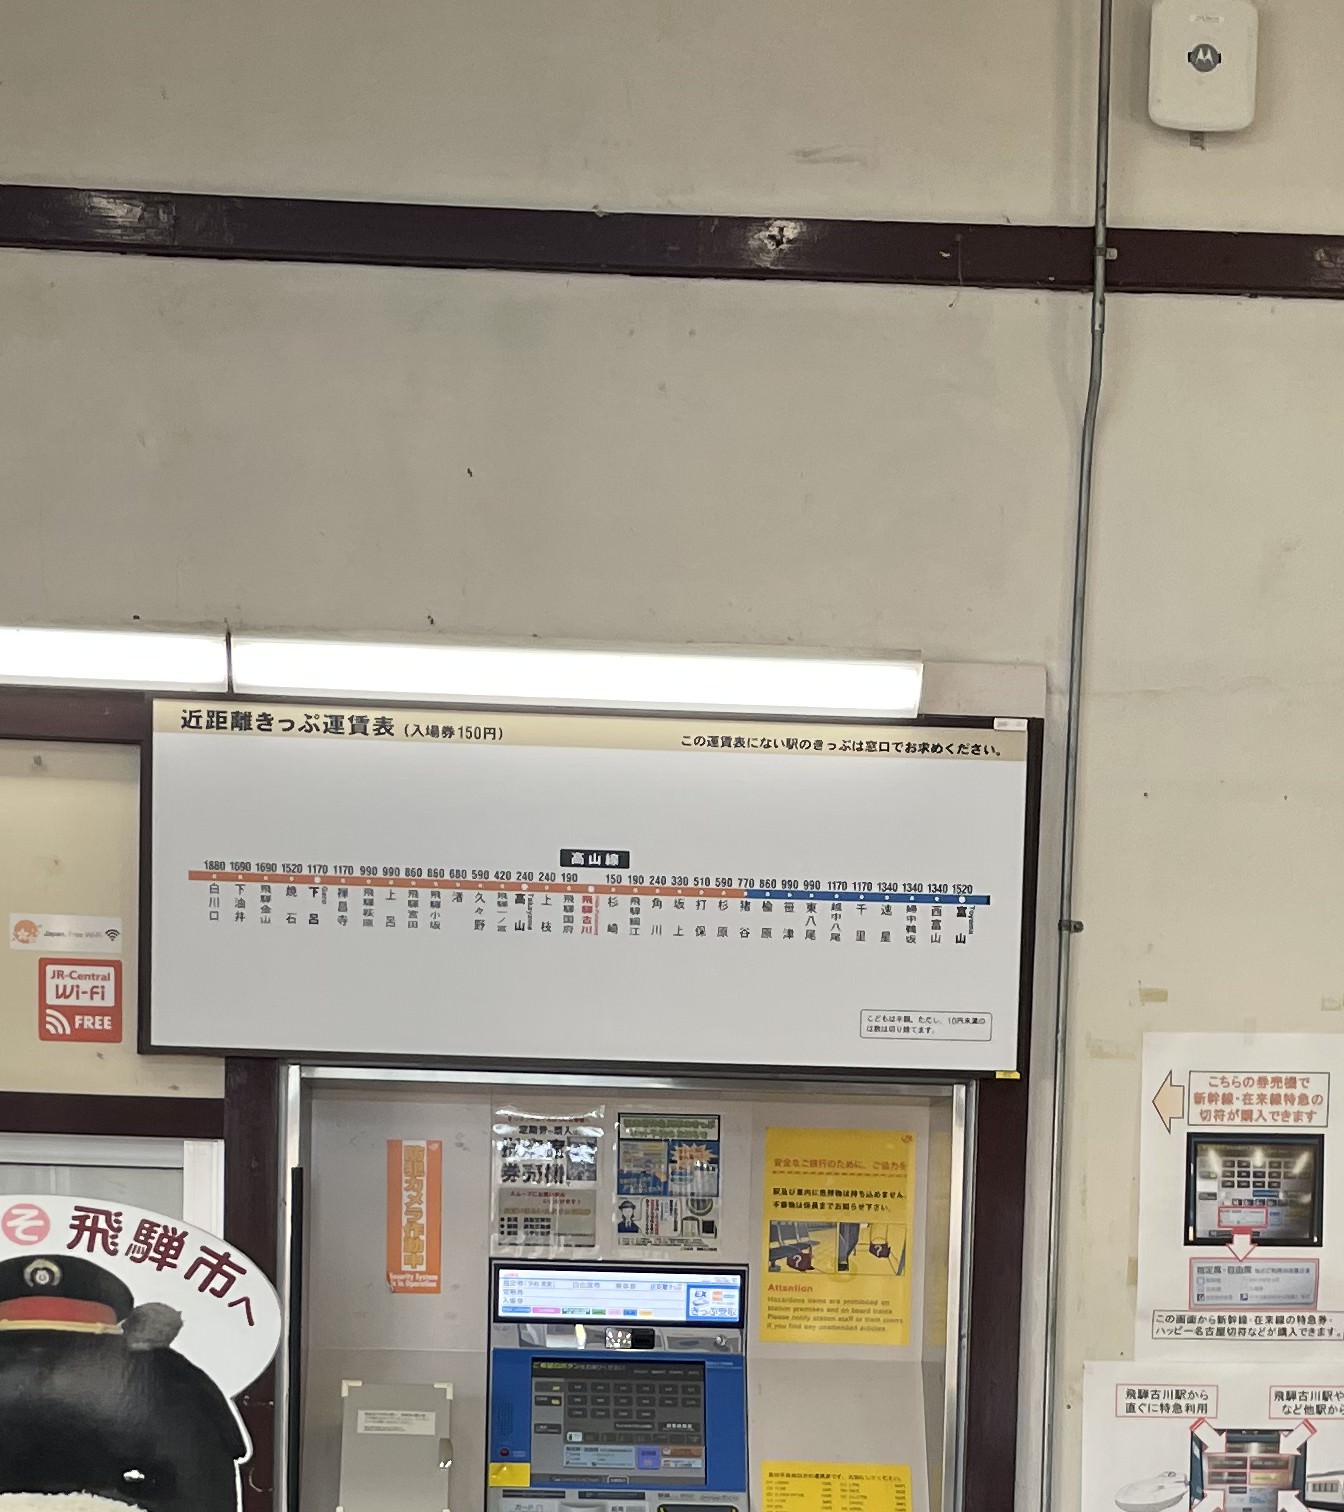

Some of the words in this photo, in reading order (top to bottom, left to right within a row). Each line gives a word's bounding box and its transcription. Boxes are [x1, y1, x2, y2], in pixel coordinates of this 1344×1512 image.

[181, 709, 395, 738] 近距離きっぷ運賃表
[405, 723, 504, 741] (入場券150円)
[681, 735, 1001, 756] この運賃表にない駅のきっぷは窓口でお求めください。
[205, 861, 225, 871] 1880
[230, 862, 251, 872] 1690
[256, 862, 277, 872] 1690
[281, 863, 303, 873] 1520
[307, 864, 328, 874] 1170
[333, 865, 354, 875] 1170
[360, 866, 378, 876] 990
[382, 867, 400, 877] 990
[472, 870, 490, 880] 590
[494, 871, 511, 881] 420
[516, 872, 533, 881] 240
[539, 872, 556, 882] 240
[561, 873, 578, 882] 190
[606, 874, 622, 884] 150
[628, 875, 644, 885] 190
[649, 876, 666, 885] 240
[694, 877, 710, 887] 510
[716, 877, 732, 887] 590
[738, 878, 754, 888] 770
[781, 880, 798, 890] 990
[803, 880, 821, 890] 990
[828, 881, 847, 891] 1170
[852, 882, 872, 891] 1170
[877, 882, 898, 892] 1340
[903, 883, 923, 893] 1340
[928, 884, 948, 893] 1340
[952, 884, 973, 894] 1520
[209, 883, 220, 921] 白川口
[308, 886, 319, 925] 下呂
[386, 889, 396, 927] 上呂
[515, 893, 525, 931] 高山
[651, 898, 663, 936] 角川
[956, 906, 967, 944] 富山
[50, 969, 111, 981] JR-Central
[56, 985, 105, 1000] Wi-Fi
[75, 1015, 112, 1030] FREE
[1208, 1076, 1310, 1089] こちらの券売機で
[1193, 1092, 1324, 1106] 新幹線・在来線特急の
[1200, 1109, 1317, 1123] 切符が購入できます
[67, 1205, 255, 1327] 飛騨市へ
[767, 1283, 813, 1293] Attention
[1125, 1388, 1209, 1401] 飛騨古川駅から
[1125, 1403, 1207, 1414] 直ぐに特急利用
